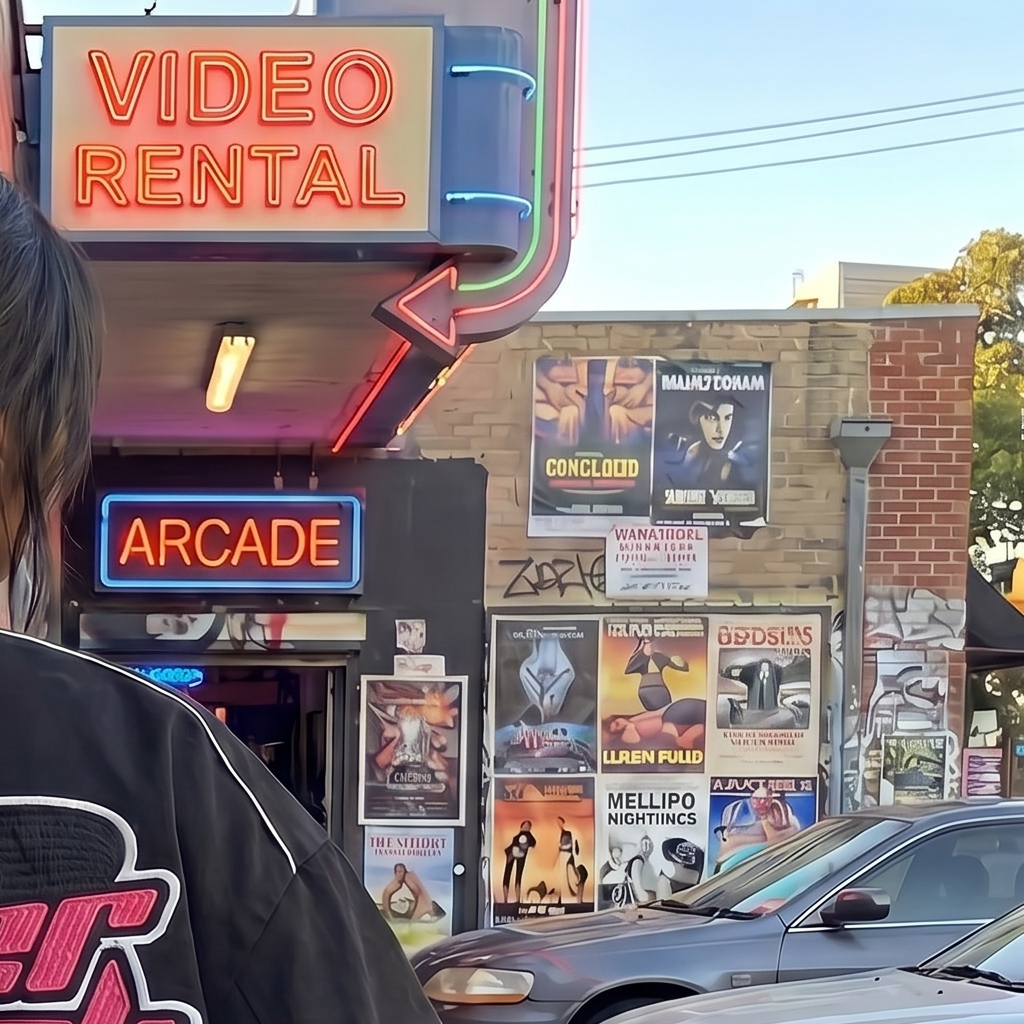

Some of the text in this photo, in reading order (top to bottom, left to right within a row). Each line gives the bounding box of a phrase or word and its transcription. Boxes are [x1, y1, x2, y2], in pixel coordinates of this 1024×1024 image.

[88, 48, 394, 126] VIDEO
[74, 143, 407, 208] RENTAL
[118, 516, 342, 568] ARCADE
[607, 792, 696, 810] MELLIPO
